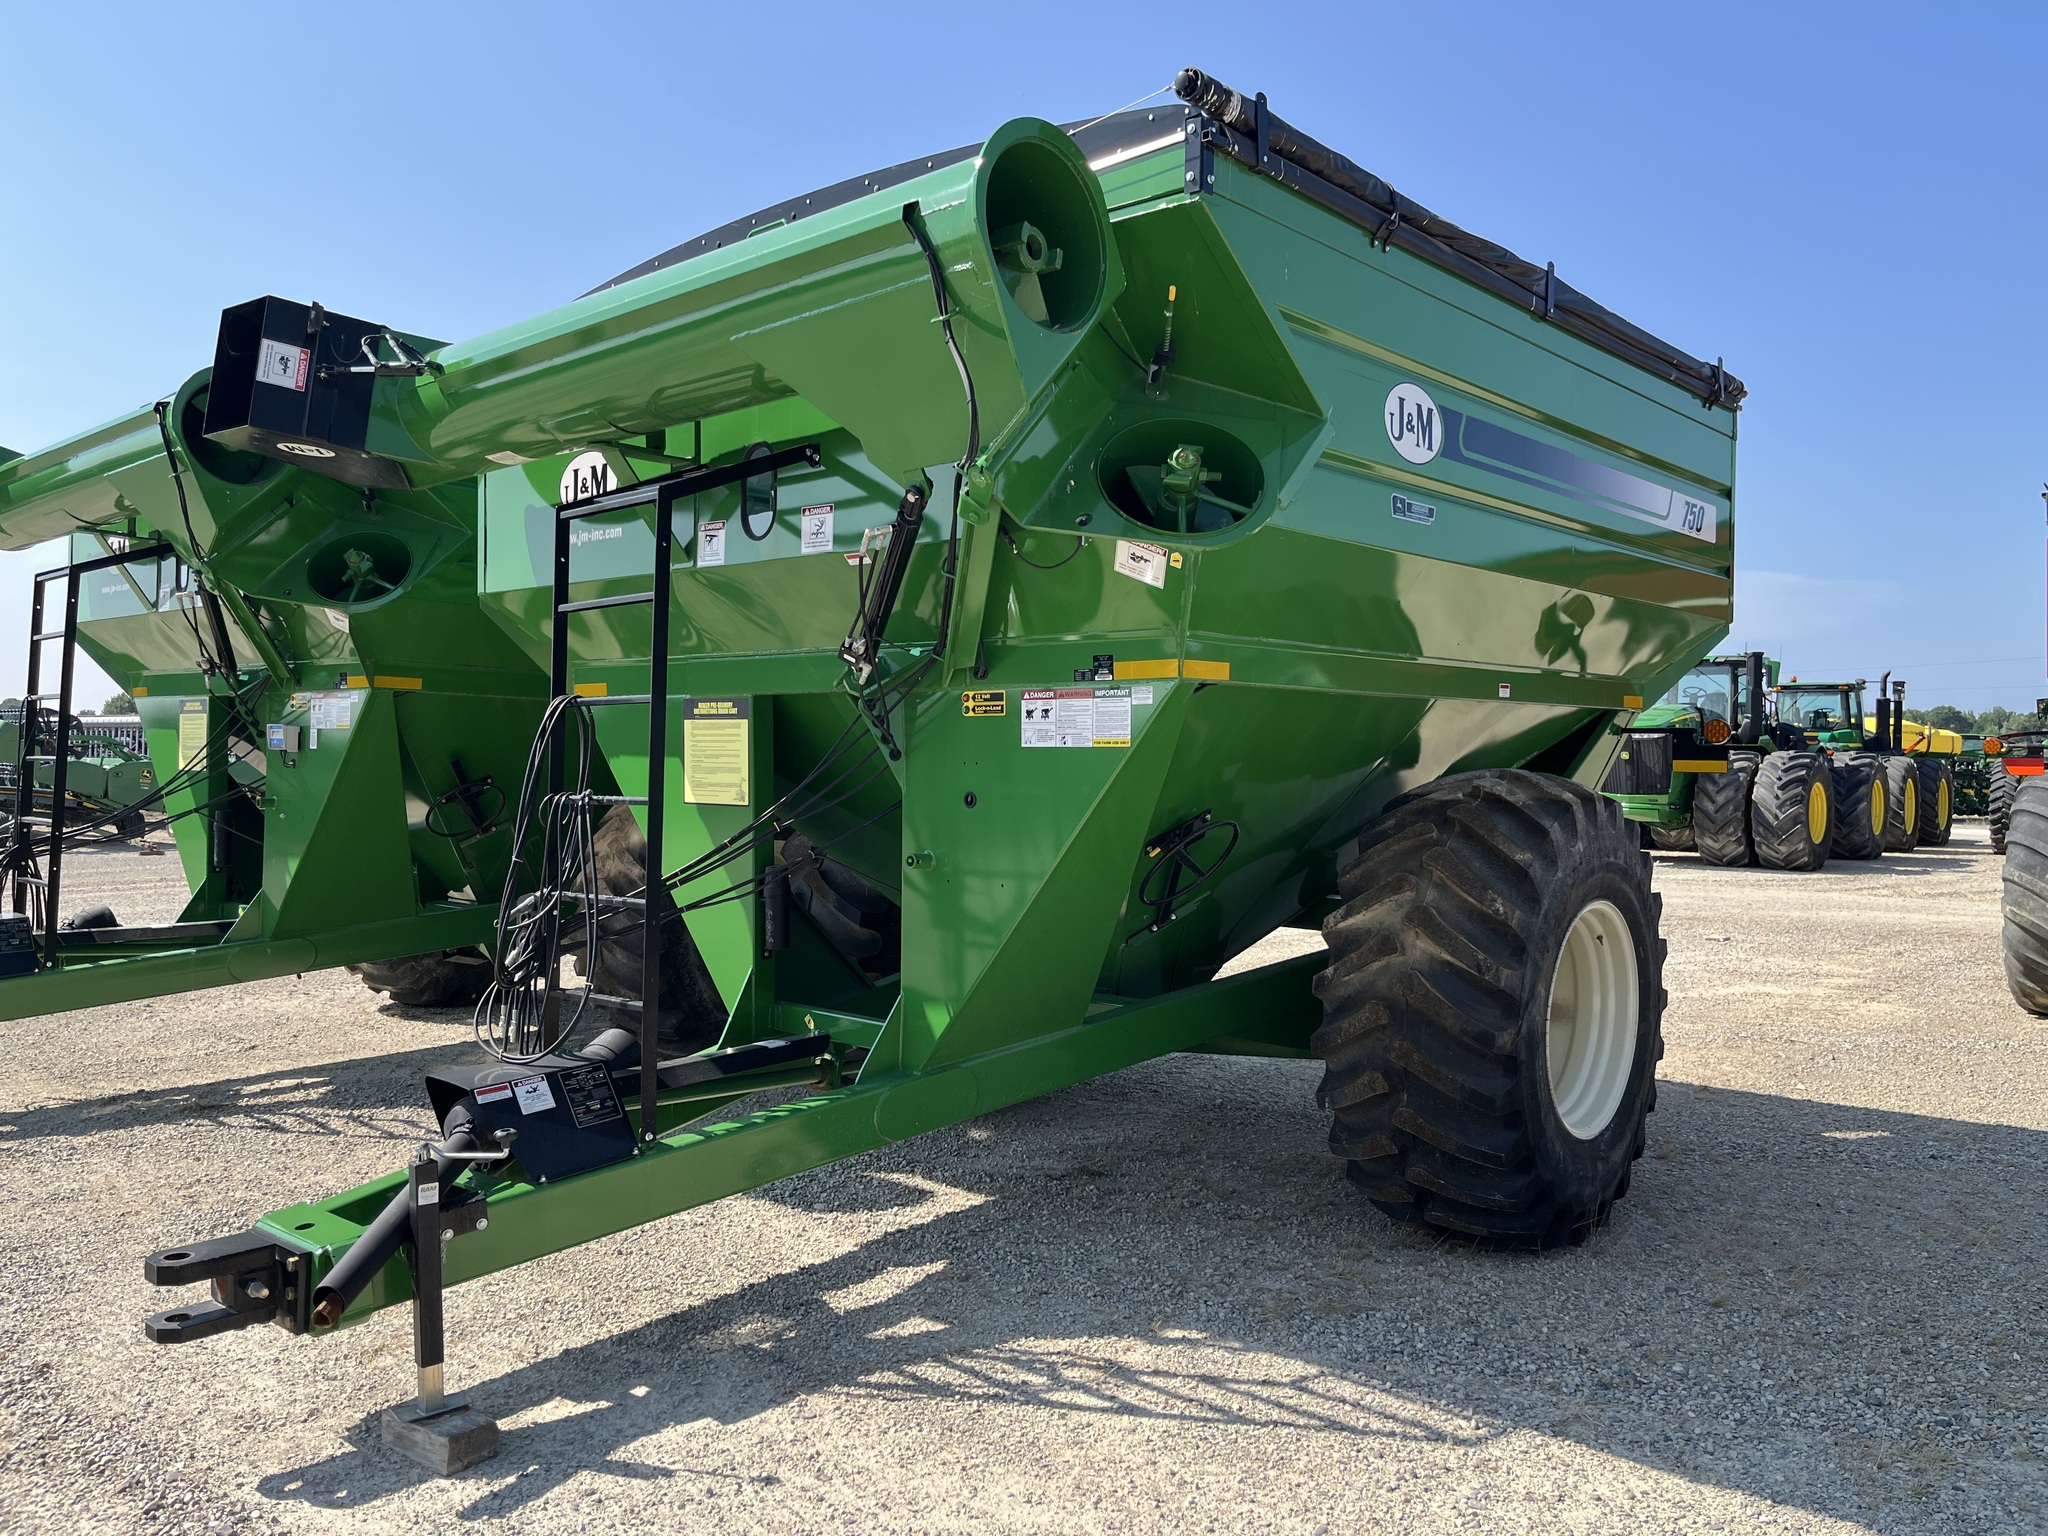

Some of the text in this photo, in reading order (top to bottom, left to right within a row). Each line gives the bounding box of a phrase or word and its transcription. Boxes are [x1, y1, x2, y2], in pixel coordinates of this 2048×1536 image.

[297, 360, 306, 386] DANGER
[1389, 396, 1433, 452] J&M
[564, 463, 608, 504] J&M
[810, 506, 830, 515] DANGER
[1682, 501, 1705, 533] 750
[706, 522, 724, 531] DANGER
[1030, 691, 1054, 699] DANGER
[1065, 690, 1092, 698] WARNING
[1094, 689, 1130, 697] IMPORTANT
[420, 1185, 437, 1194] RAM
